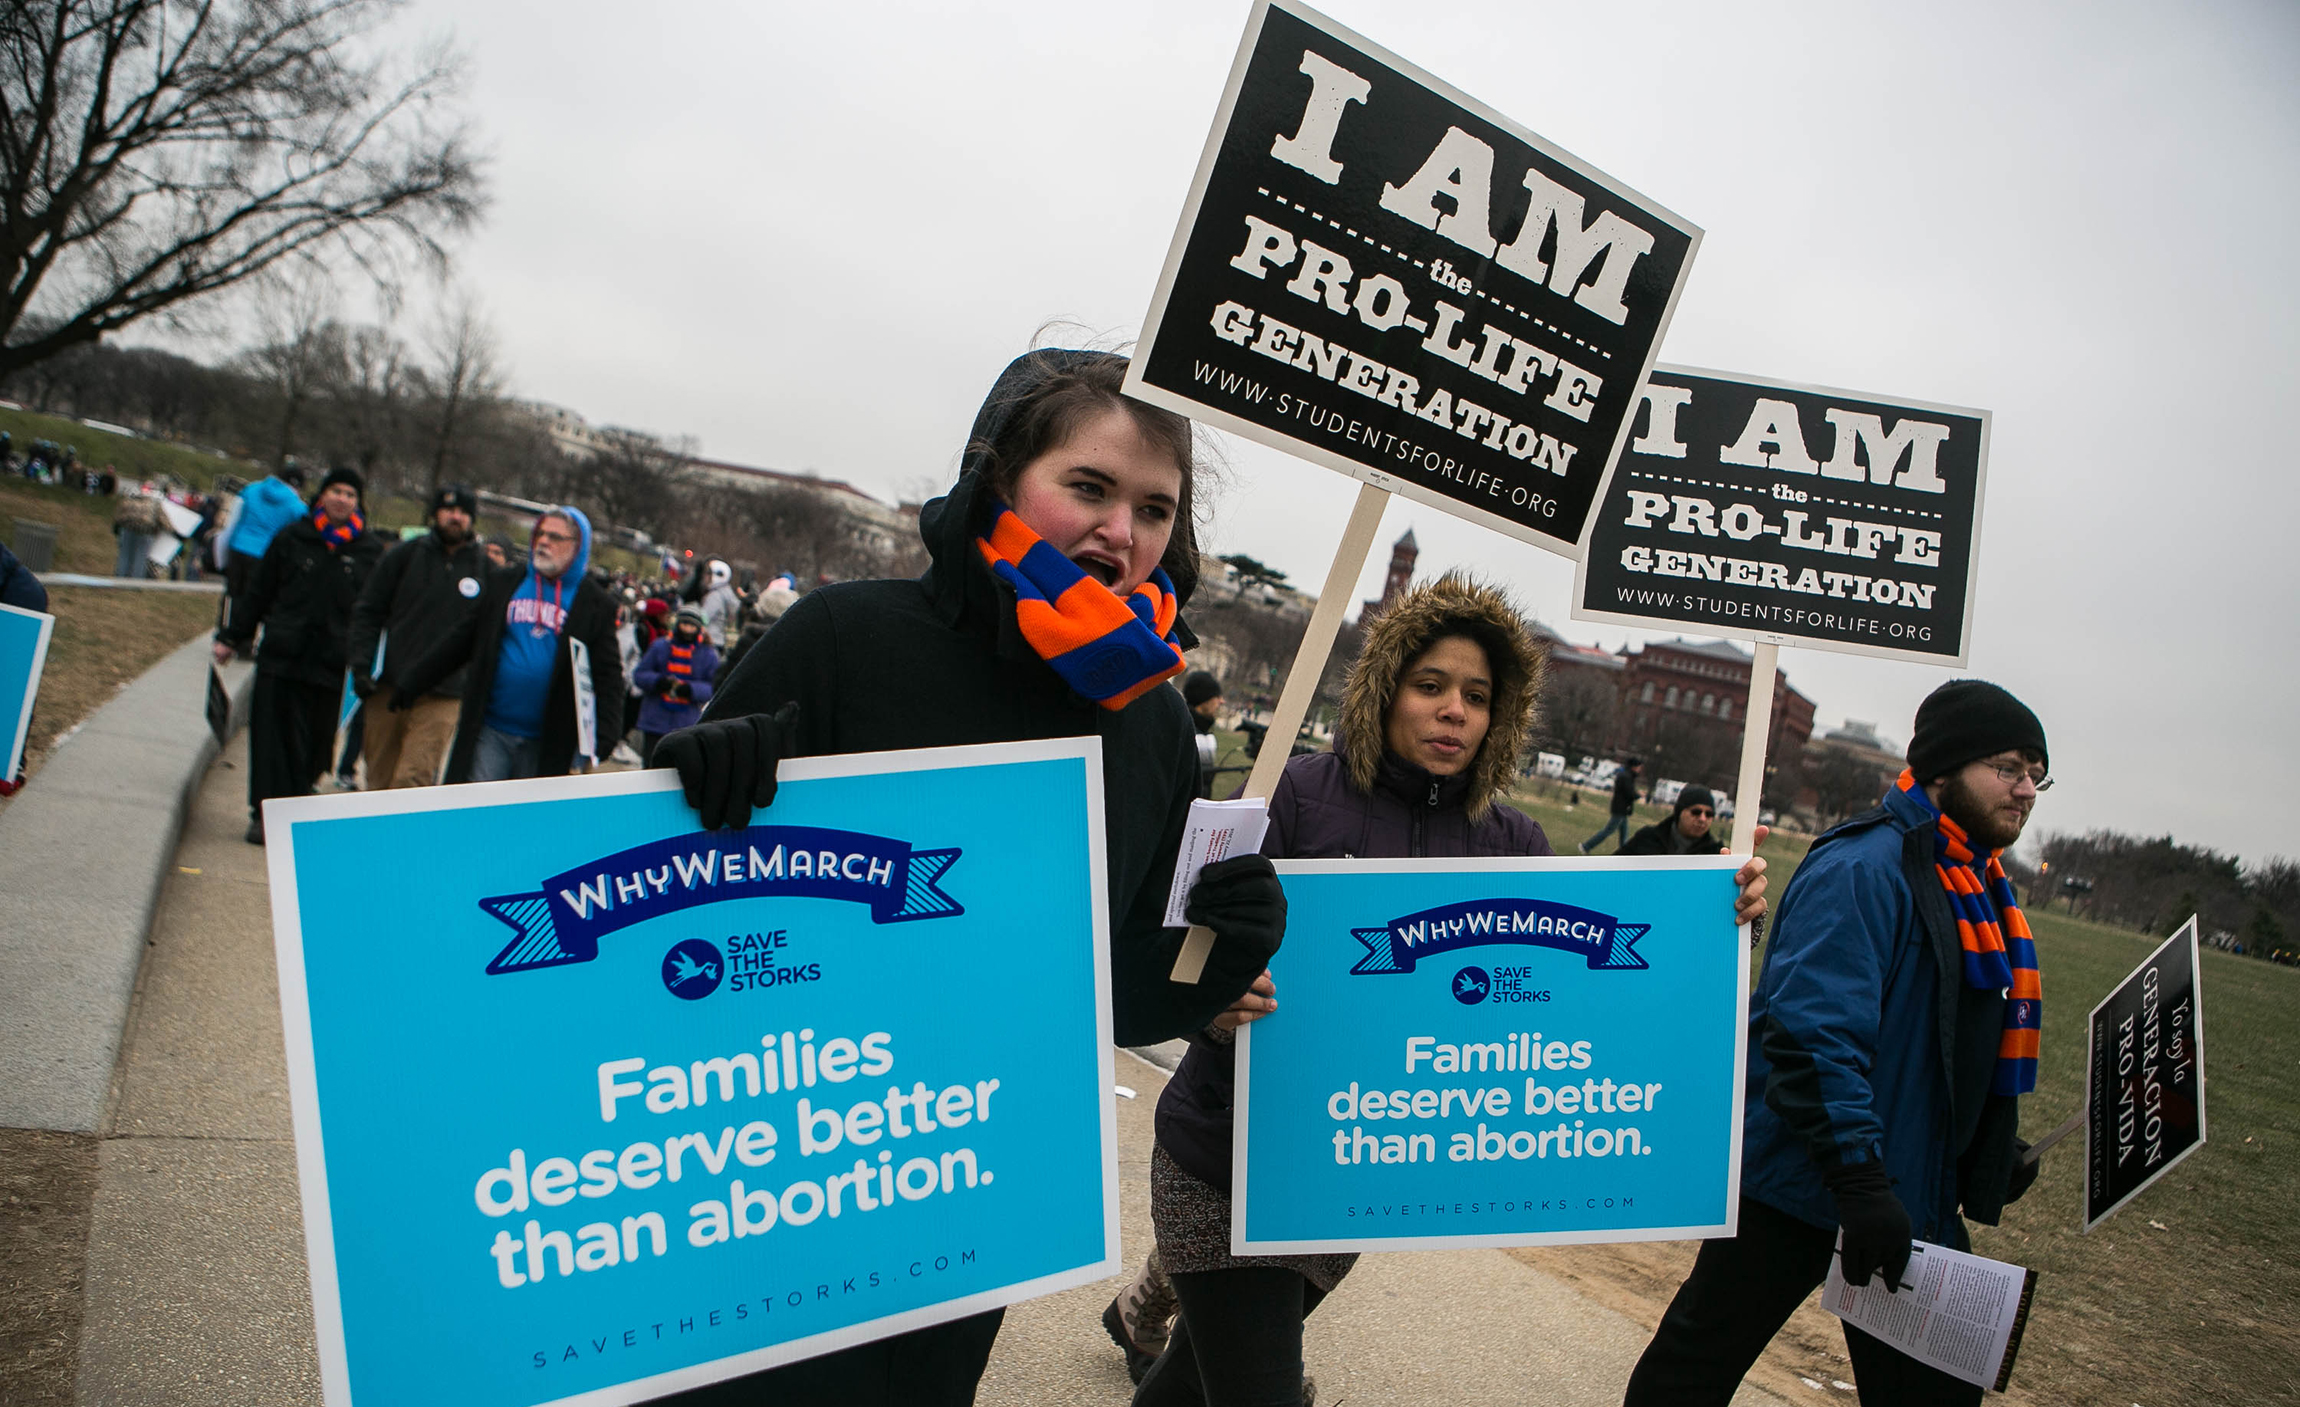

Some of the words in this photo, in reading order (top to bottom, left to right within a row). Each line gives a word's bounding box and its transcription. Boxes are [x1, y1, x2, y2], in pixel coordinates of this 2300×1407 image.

[1270, 49, 1371, 185] I
[1379, 126, 1655, 325] AM
[1430, 258, 1472, 295] the
[1231, 215, 1603, 422] PRO-LIFE
[1210, 300, 1577, 476] GENERATION
[1633, 384, 1692, 458] I
[1720, 398, 1949, 494] AM
[1772, 483, 1808, 503] the
[1624, 490, 1942, 567] PRO-LIFE
[1621, 546, 1936, 609] GENERATION
[726, 930, 788, 954] SAVE
[728, 952, 774, 972] THE
[730, 964, 822, 993] STORKS
[1493, 966, 1532, 979] SAVE
[1493, 979, 1523, 991] THE
[1492, 990, 1551, 1003] STORKS
[2171, 997, 2189, 1027] Yo
[1405, 1032, 1592, 1074] Families
[2142, 966, 2162, 1168] GENERACION
[2166, 1029, 2183, 1060] soy
[597, 1027, 894, 1123] Families
[2118, 1013, 2135, 1168] PRO-VIDA
[2174, 1057, 2191, 1085] la
[1327, 1081, 1511, 1121] deserve
[1525, 1076, 1662, 1116] better
[474, 1120, 778, 1217] deserve
[797, 1077, 1000, 1157] better
[1333, 1126, 1436, 1165] than
[1448, 1119, 1652, 1162] abortion.
[490, 1210, 668, 1288] than
[687, 1147, 995, 1247] abortion.
[1347, 1197, 1635, 1217] SAVETHESTORKS.COM
[533, 1249, 977, 1368] SAVETHESTORKS.COM
